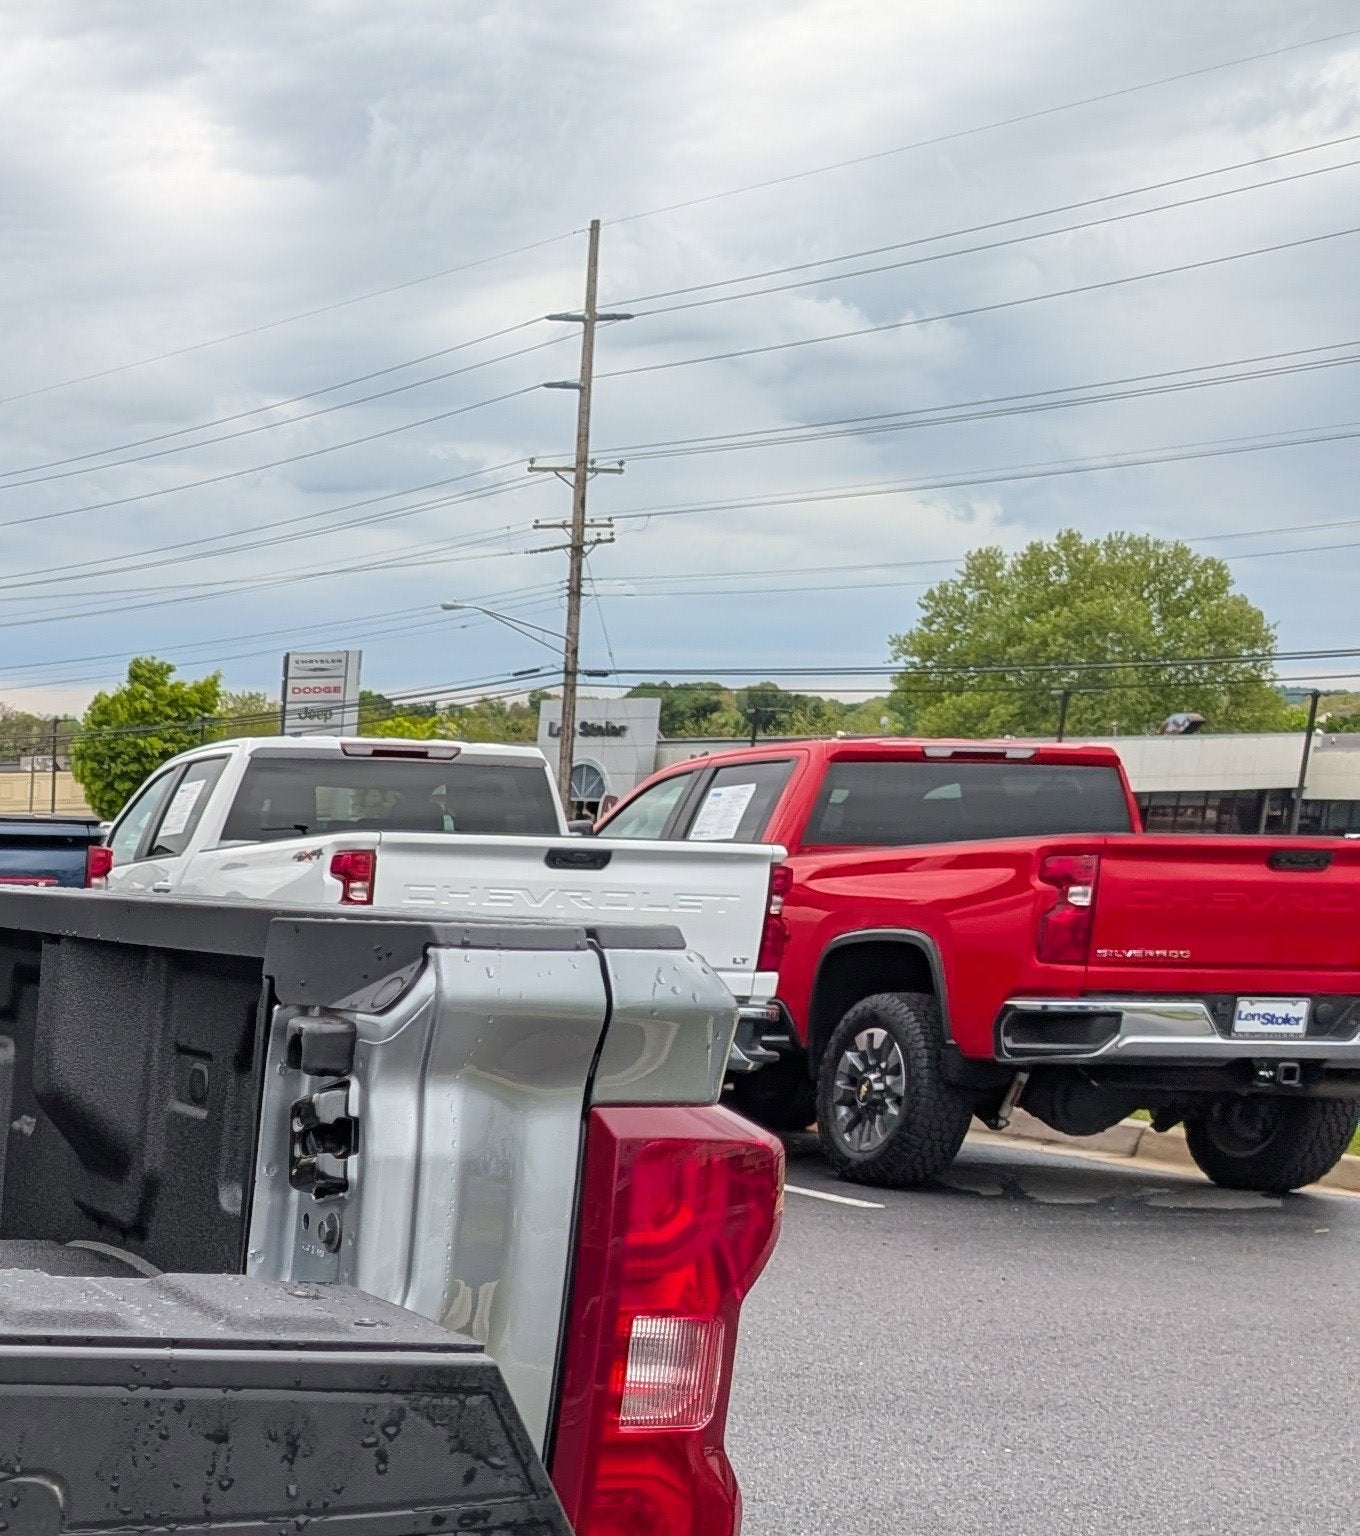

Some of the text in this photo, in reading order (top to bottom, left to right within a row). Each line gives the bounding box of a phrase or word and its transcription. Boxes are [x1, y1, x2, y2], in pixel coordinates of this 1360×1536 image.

[291, 686, 341, 695] DODGE
[402, 883, 741, 914] CHEVROLET
[732, 957, 749, 965] LT
